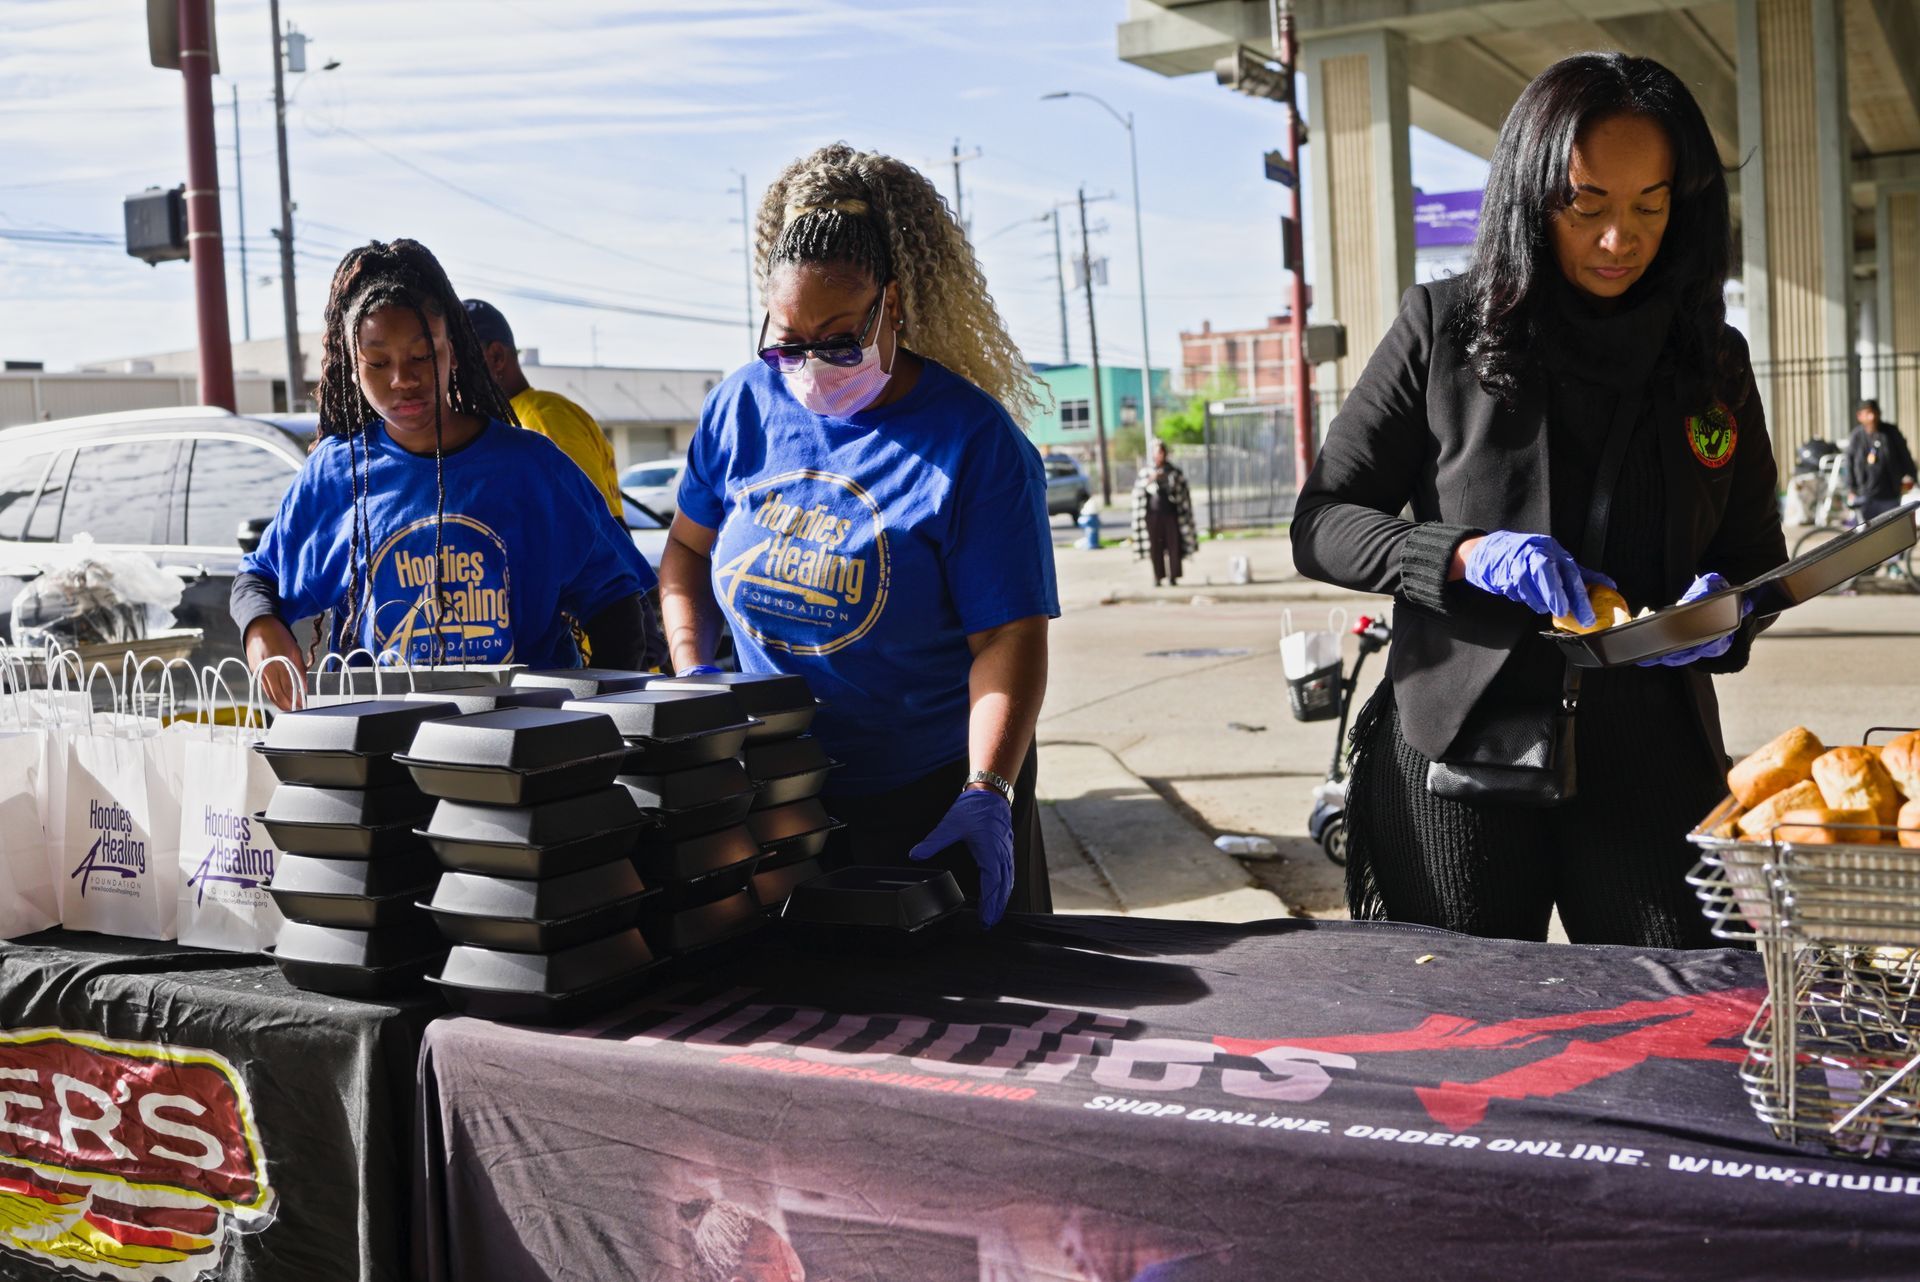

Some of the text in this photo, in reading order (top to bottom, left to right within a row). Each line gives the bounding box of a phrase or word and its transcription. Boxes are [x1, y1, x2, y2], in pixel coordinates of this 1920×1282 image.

[753, 490, 852, 545] Hoodies
[394, 545, 485, 588] Hoodies
[764, 530, 866, 605] Healing
[423, 580, 510, 629] Healing
[742, 588, 849, 621] FOUNDATION
[412, 639, 503, 652] FODATION
[89, 799, 132, 832] Hoodies
[204, 804, 251, 841] Hoodies
[102, 831, 146, 874] Healing
[216, 838, 275, 881] Healing
[90, 877, 141, 889] FOUNDATION
[206, 887, 270, 900] ONDATION
[1083, 1096, 1187, 1119] SHOP
[1187, 1107, 1331, 1134] ONLINE.
[1344, 1124, 1481, 1150] ORDER
[1486, 1137, 1651, 1167] ONLINE.
